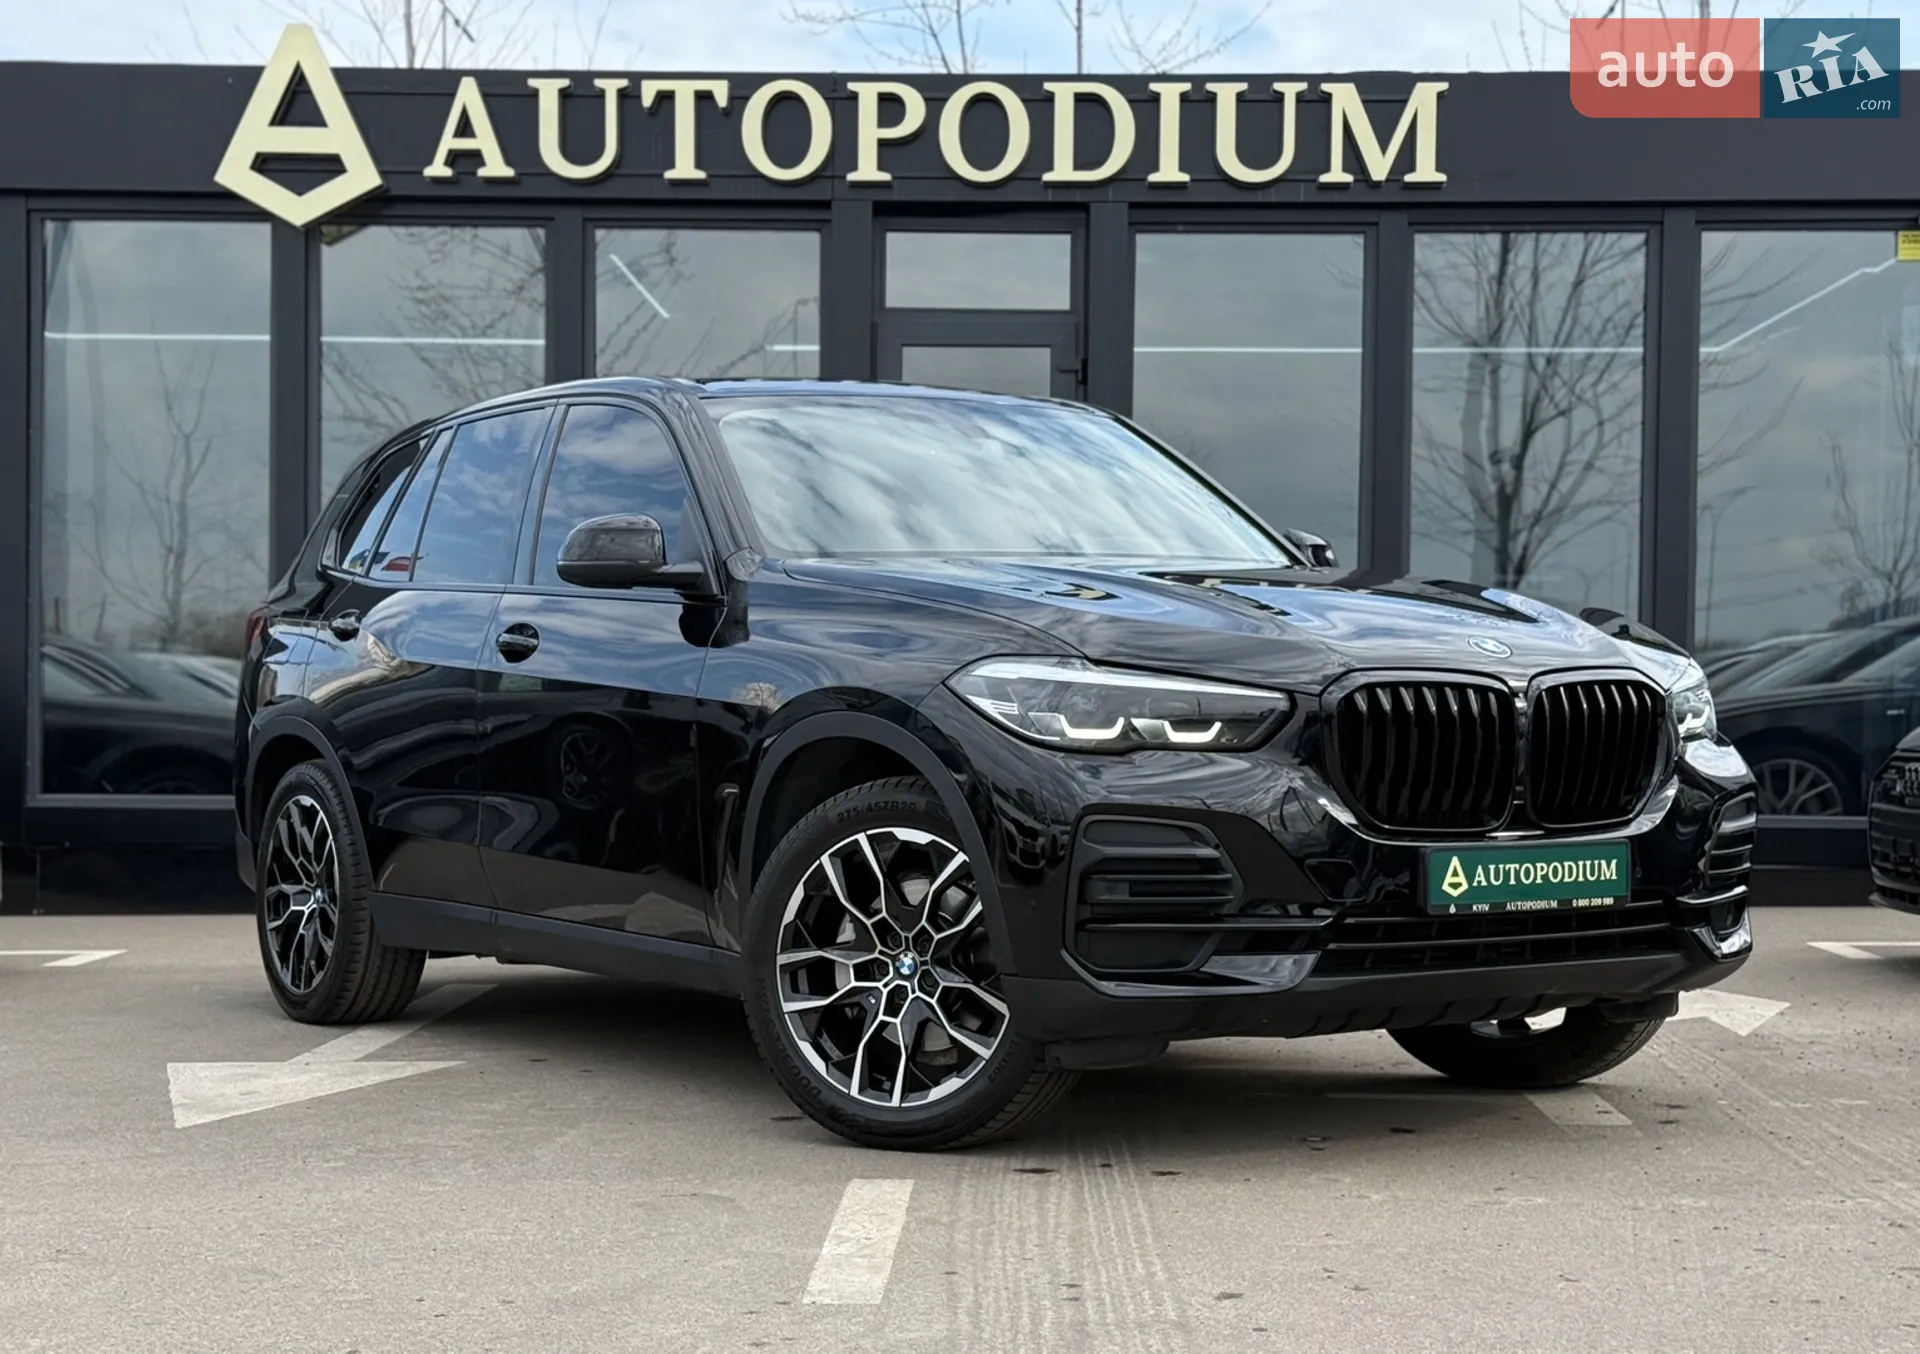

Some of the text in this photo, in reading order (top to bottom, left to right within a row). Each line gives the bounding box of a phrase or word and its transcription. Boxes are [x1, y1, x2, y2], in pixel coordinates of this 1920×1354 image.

[422, 77, 1450, 187] AUTOPODIUM
[1472, 859, 1618, 887] AUTOPODIUM
[1472, 904, 1490, 913] KYIV
[1505, 899, 1558, 912] AUTOPODIUM
